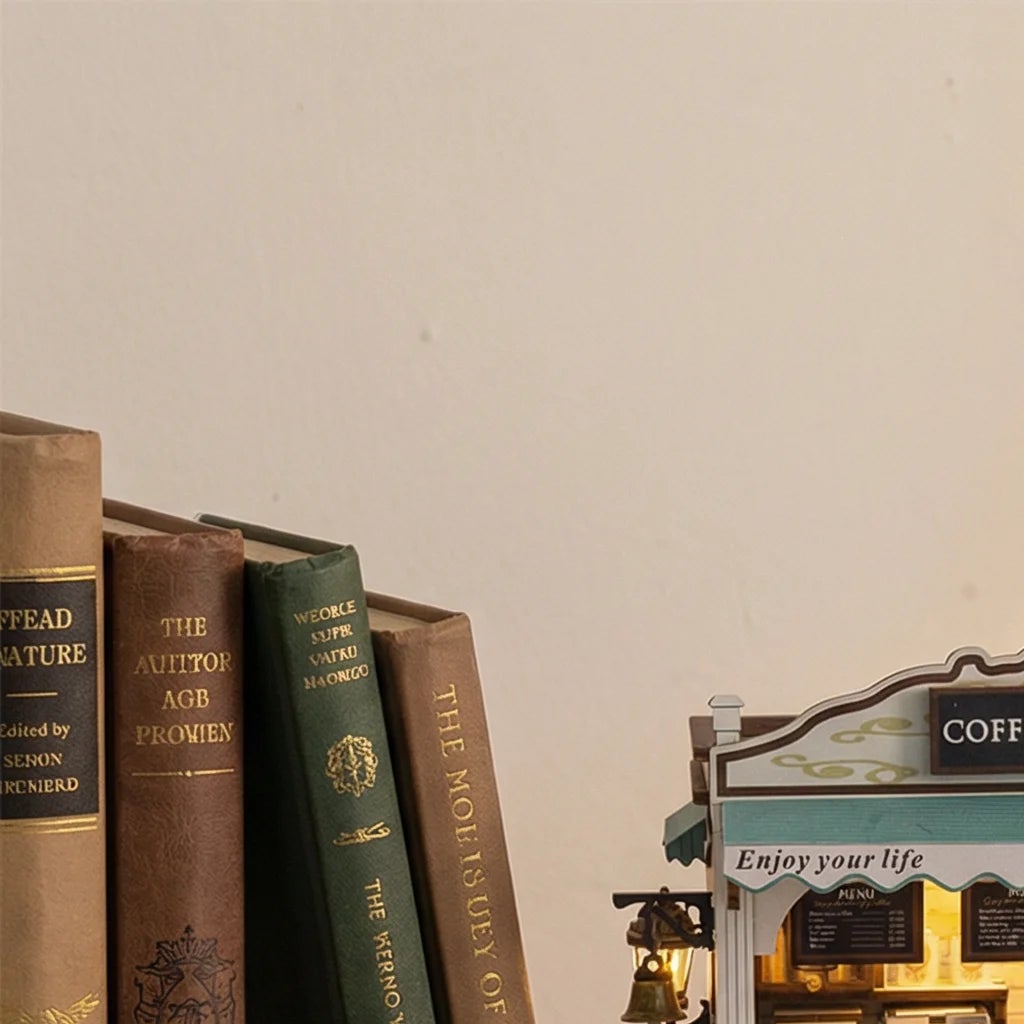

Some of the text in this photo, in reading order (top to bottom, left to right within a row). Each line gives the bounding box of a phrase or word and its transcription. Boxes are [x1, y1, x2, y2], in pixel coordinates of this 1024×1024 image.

[52, 722, 71, 739] by
[736, 848, 924, 875] Enjoy your life
[364, 878, 387, 921] THE
